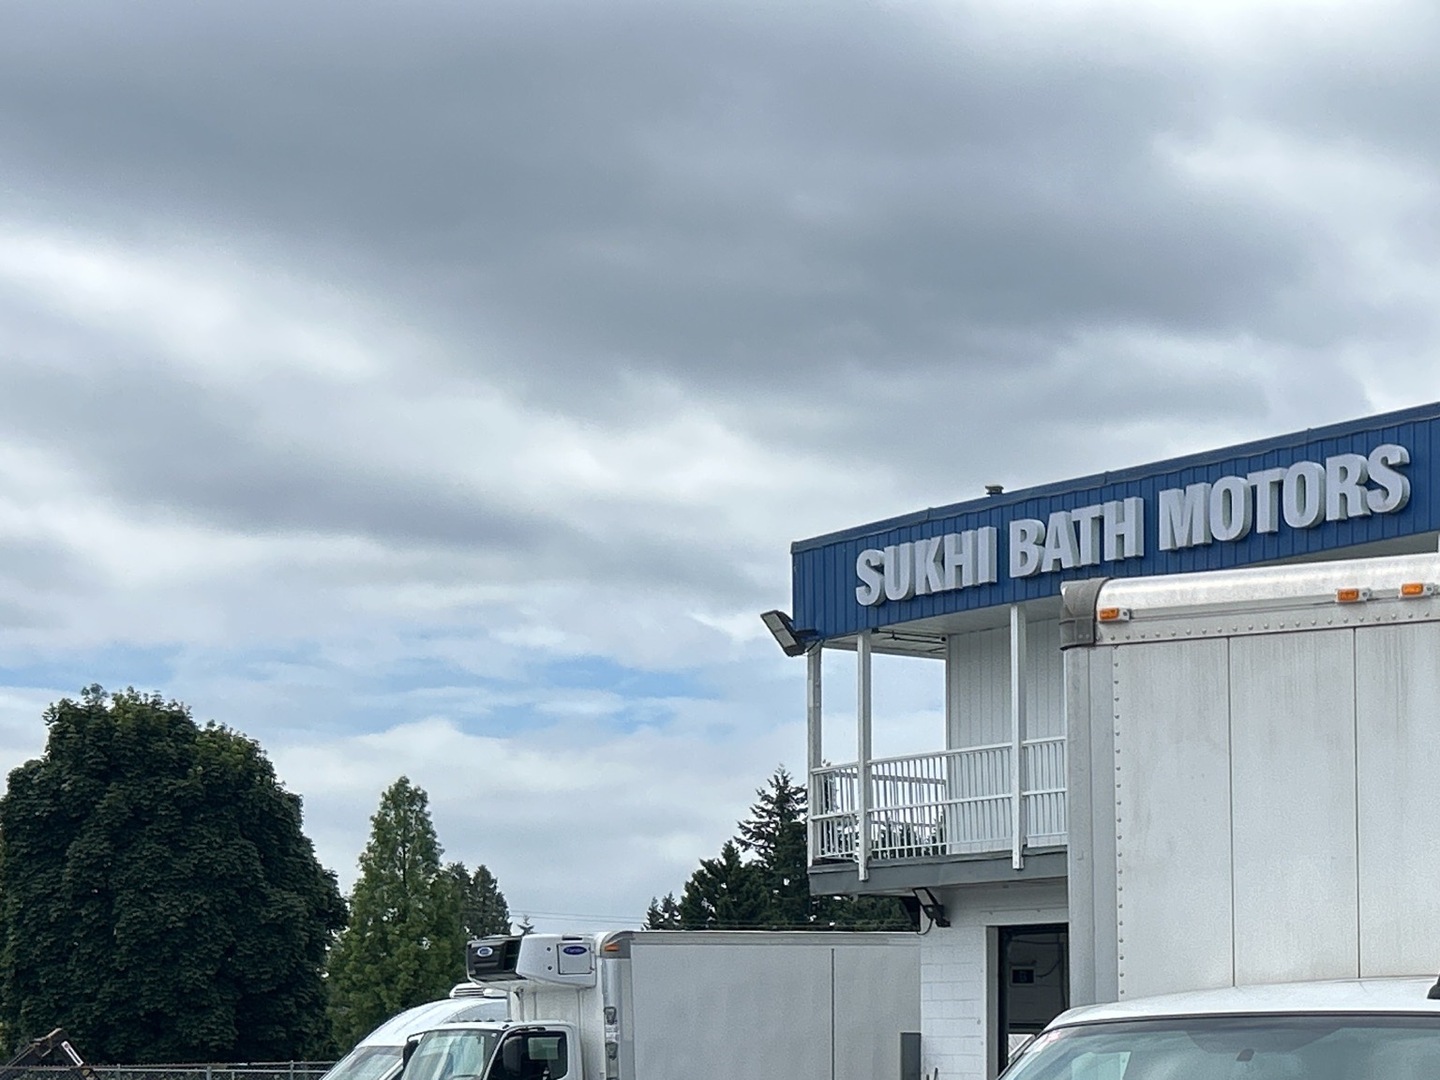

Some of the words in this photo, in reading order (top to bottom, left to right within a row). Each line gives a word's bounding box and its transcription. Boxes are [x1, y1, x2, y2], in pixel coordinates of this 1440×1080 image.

[855, 525, 998, 607] SUKHI
[1009, 496, 1145, 579] BATH
[1158, 443, 1411, 551] MOTORS
